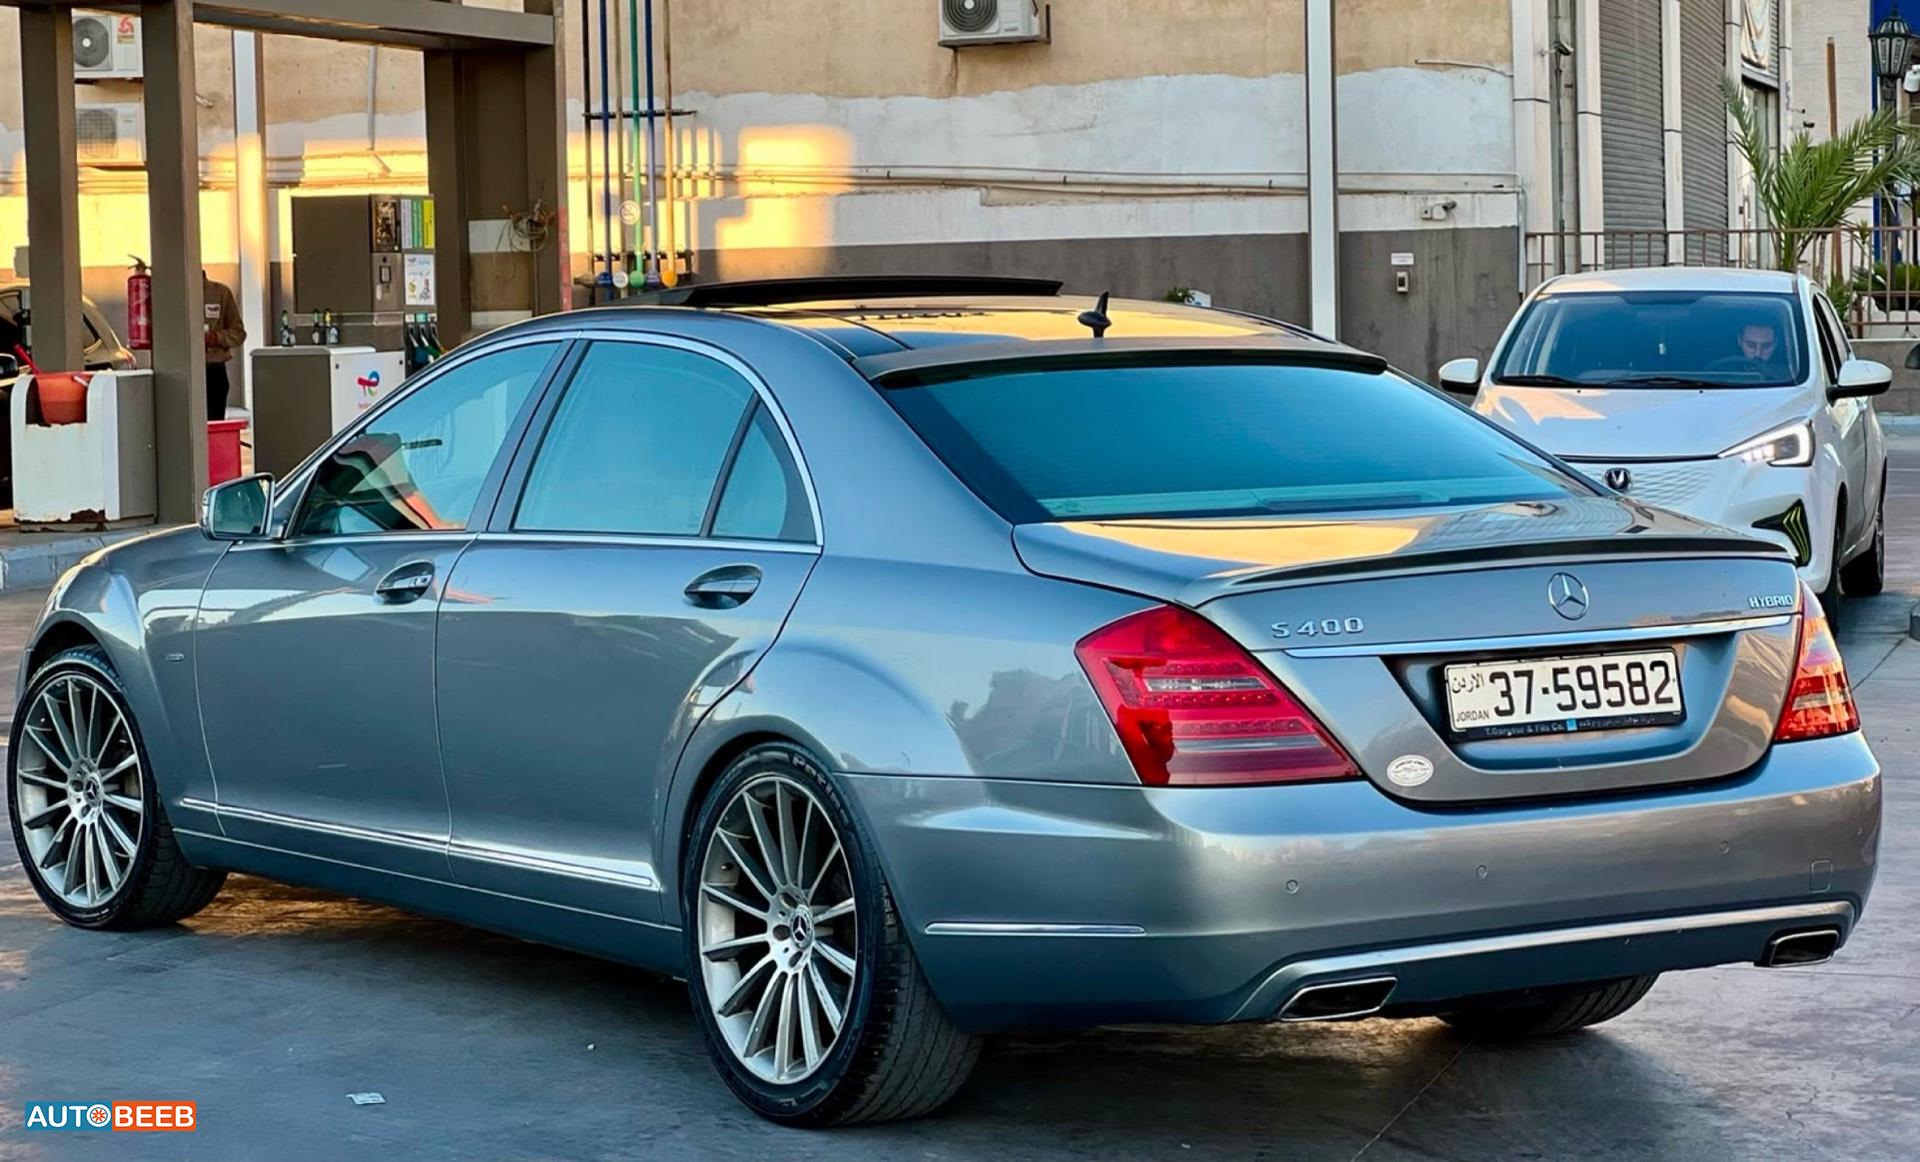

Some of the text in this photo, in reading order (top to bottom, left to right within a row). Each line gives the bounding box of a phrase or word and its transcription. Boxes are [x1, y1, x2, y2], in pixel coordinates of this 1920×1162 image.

[1749, 594, 1794, 609] HYBRID
[1271, 616, 1365, 638] S 400
[1456, 709, 1490, 722] JORDAN
